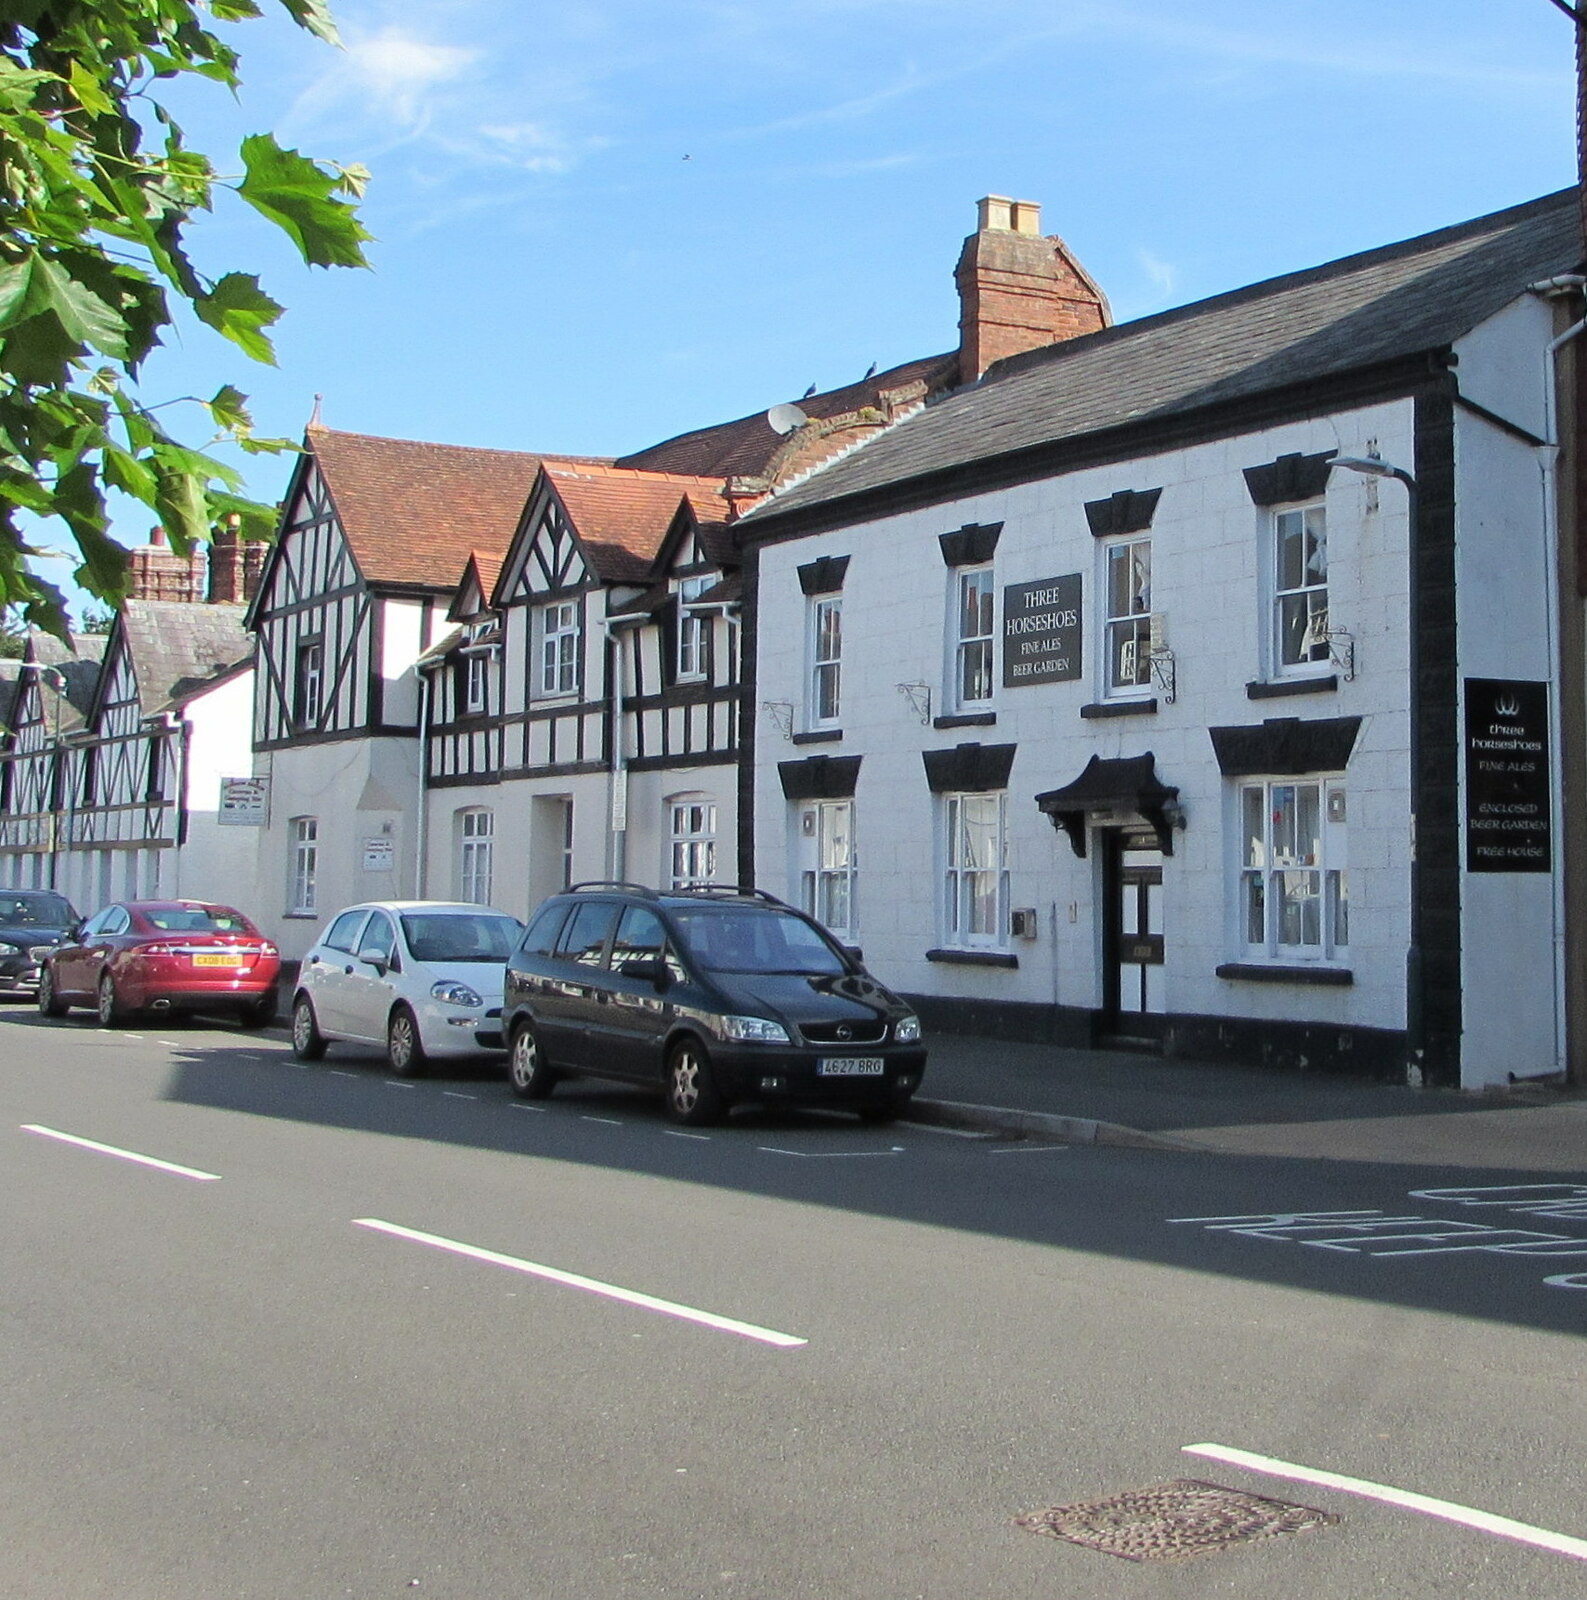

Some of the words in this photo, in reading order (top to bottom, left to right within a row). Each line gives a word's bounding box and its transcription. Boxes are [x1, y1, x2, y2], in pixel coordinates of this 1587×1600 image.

[1024, 587, 1059, 609] THREE
[1006, 609, 1077, 636] HORSESHOES
[1021, 640, 1040, 655] FINE
[1040, 637, 1062, 652] ALES
[1013, 662, 1033, 677] BEER
[1033, 658, 1070, 674] GARDEN
[1479, 760, 1505, 771] FINE
[1507, 762, 1535, 772] ALES
[1479, 803, 1538, 814] ENCLOSED
[1470, 819, 1500, 830] BEER
[1501, 820, 1548, 831] GARDEN
[1476, 847, 1505, 856] FREE
[1507, 847, 1545, 857] HOUSE
[825, 1059, 855, 1073] 4627
[858, 1059, 882, 1073] BRG
